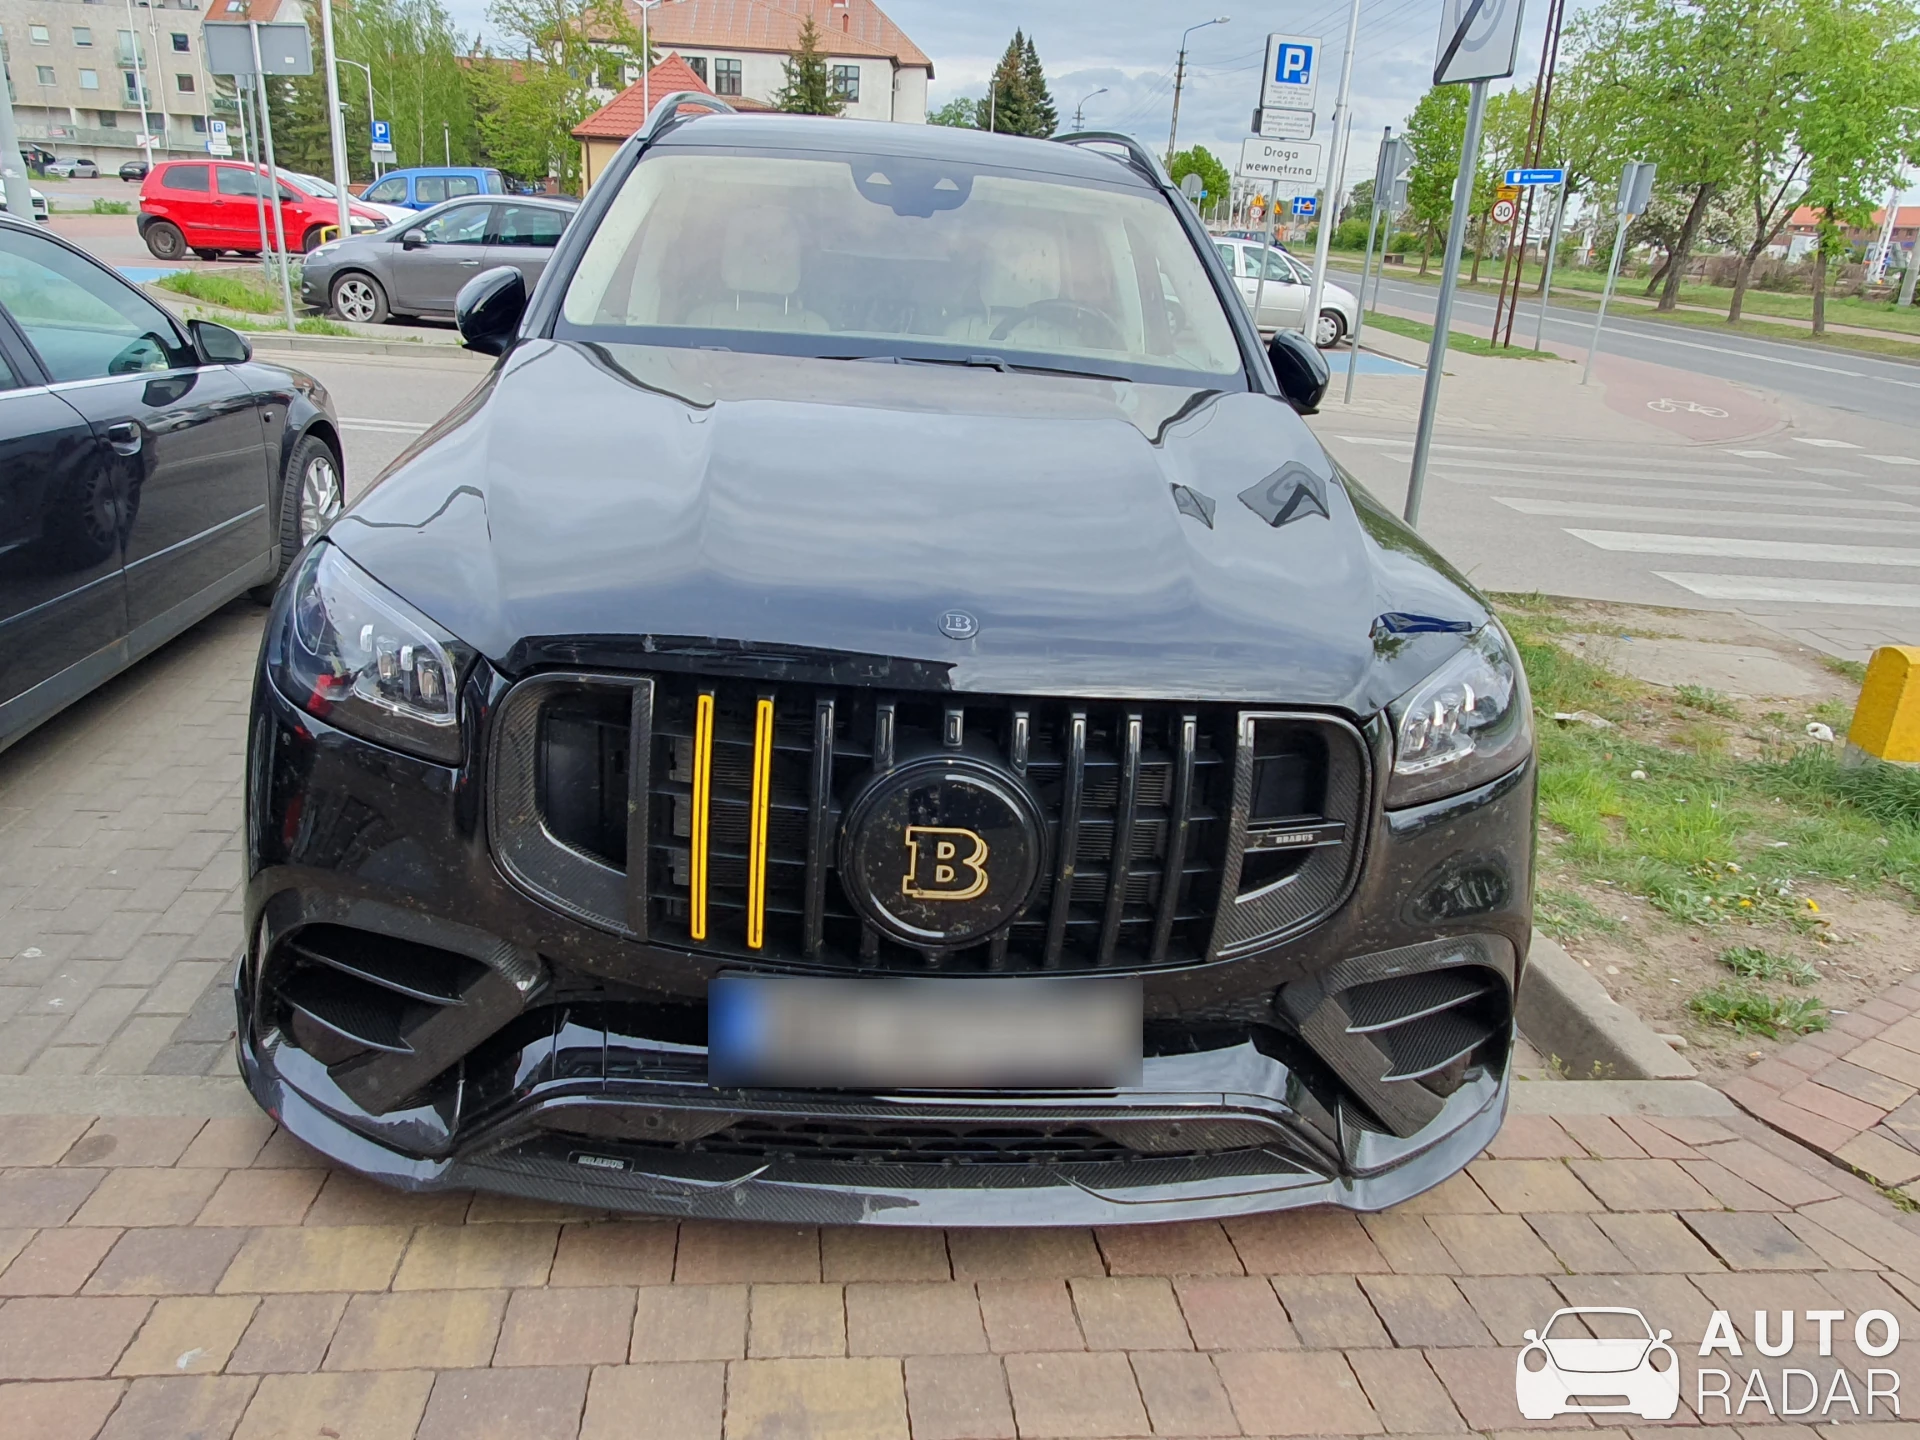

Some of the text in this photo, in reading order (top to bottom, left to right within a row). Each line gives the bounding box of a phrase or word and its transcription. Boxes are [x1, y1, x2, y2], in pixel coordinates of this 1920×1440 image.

[1283, 48, 1305, 79] P
[375, 123, 386, 138] P
[1264, 146, 1299, 161] Droga
[1246, 163, 1312, 176] wewnętrzna
[1495, 205, 1511, 218] 30
[946, 613, 972, 632] B
[902, 825, 989, 900] B
